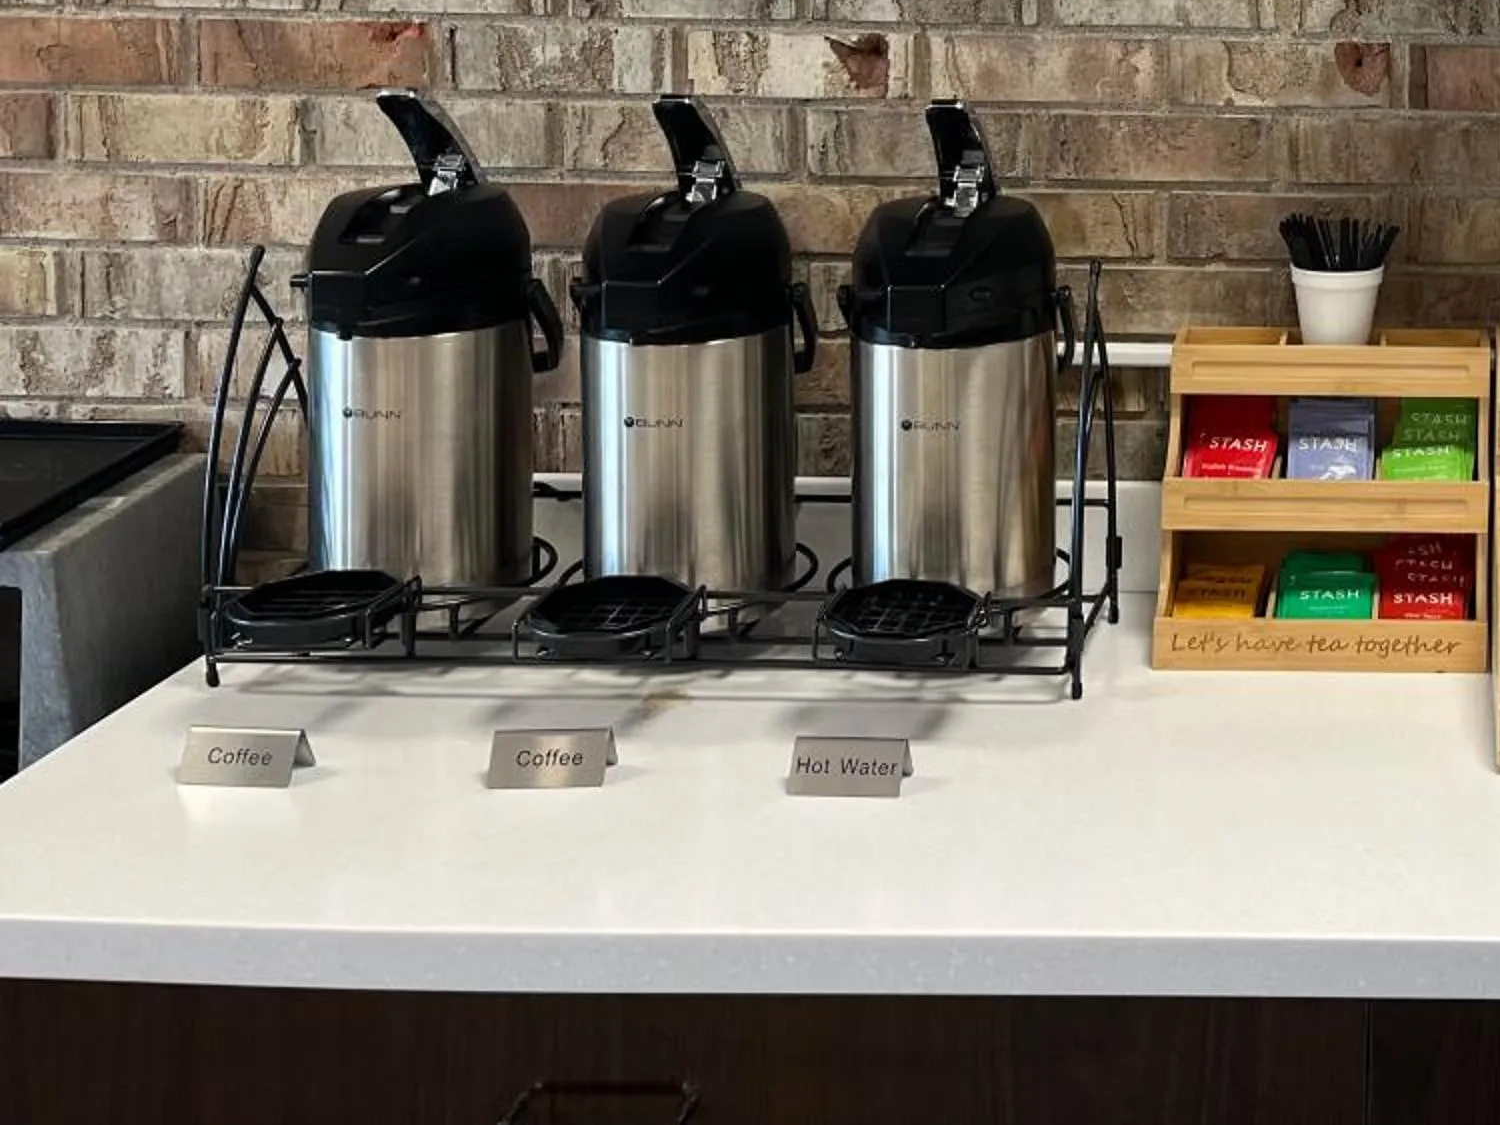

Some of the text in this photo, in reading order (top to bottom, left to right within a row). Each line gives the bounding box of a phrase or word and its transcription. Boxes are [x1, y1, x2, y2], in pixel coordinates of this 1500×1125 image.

[1209, 436, 1268, 452] STASH
[1391, 444, 1450, 459] STASH
[1299, 589, 1360, 601] STASH
[1393, 592, 1454, 606] STASH
[1171, 632, 1462, 659] Let's have tea together
[207, 746, 273, 766] Coffee
[516, 748, 583, 768] Coffee
[796, 756, 899, 776] Hot Water
